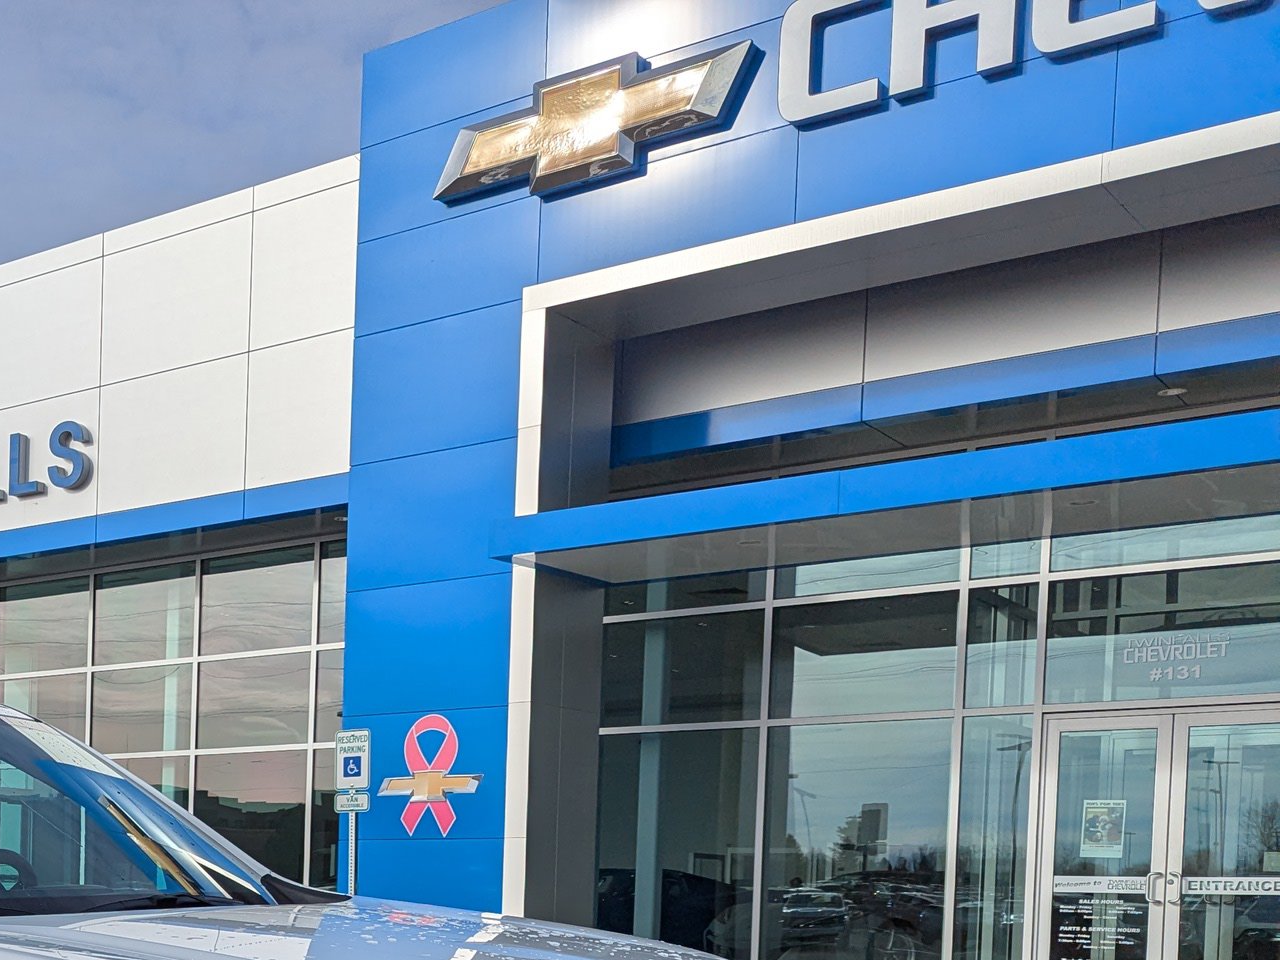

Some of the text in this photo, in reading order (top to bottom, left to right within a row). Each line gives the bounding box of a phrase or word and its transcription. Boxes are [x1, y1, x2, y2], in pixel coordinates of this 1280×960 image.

[1123, 641, 1230, 664] CHEVROLET
[1149, 665, 1202, 681] #131
[337, 734, 368, 744] RESERVED
[339, 745, 366, 754] PARKING
[1187, 880, 1280, 891] ENTRANCE
